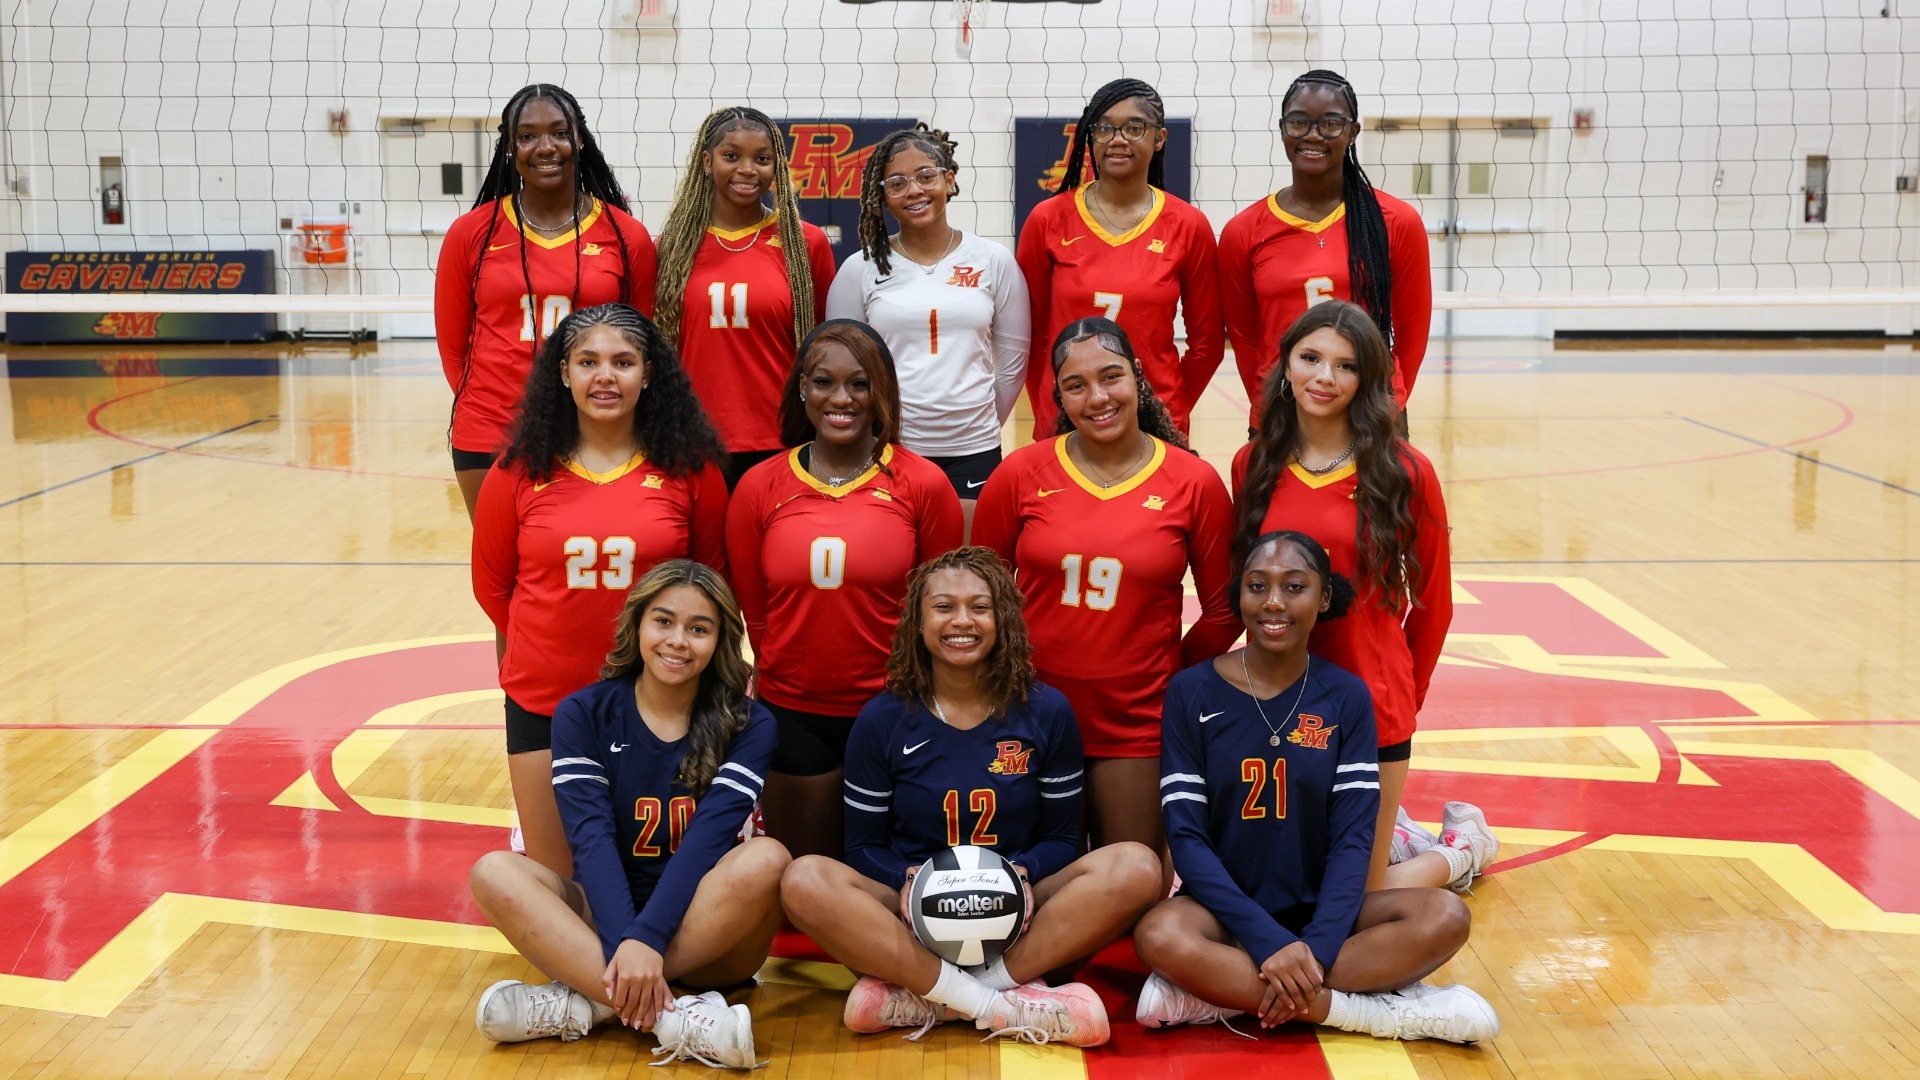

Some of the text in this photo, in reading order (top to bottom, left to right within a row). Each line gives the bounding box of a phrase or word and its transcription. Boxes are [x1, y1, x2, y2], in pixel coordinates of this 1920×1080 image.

[20, 263, 246, 289] CAVALIERS
[50, 253, 215, 262] PURCELL MARIAN
[950, 265, 985, 288] PM
[519, 293, 572, 341] 10
[708, 282, 750, 329] 11
[1093, 291, 1124, 323] 7
[928, 308, 939, 356] 1
[563, 535, 637, 590] 23
[809, 536, 847, 590] 0
[1060, 553, 1124, 612] 19
[1295, 713, 1336, 749] PM
[993, 740, 1034, 775] PM
[1241, 757, 1287, 820] 21
[632, 795, 697, 857] 20
[943, 788, 998, 847] 12
[937, 872, 1000, 888] Super Touch
[937, 894, 1004, 912] molten
